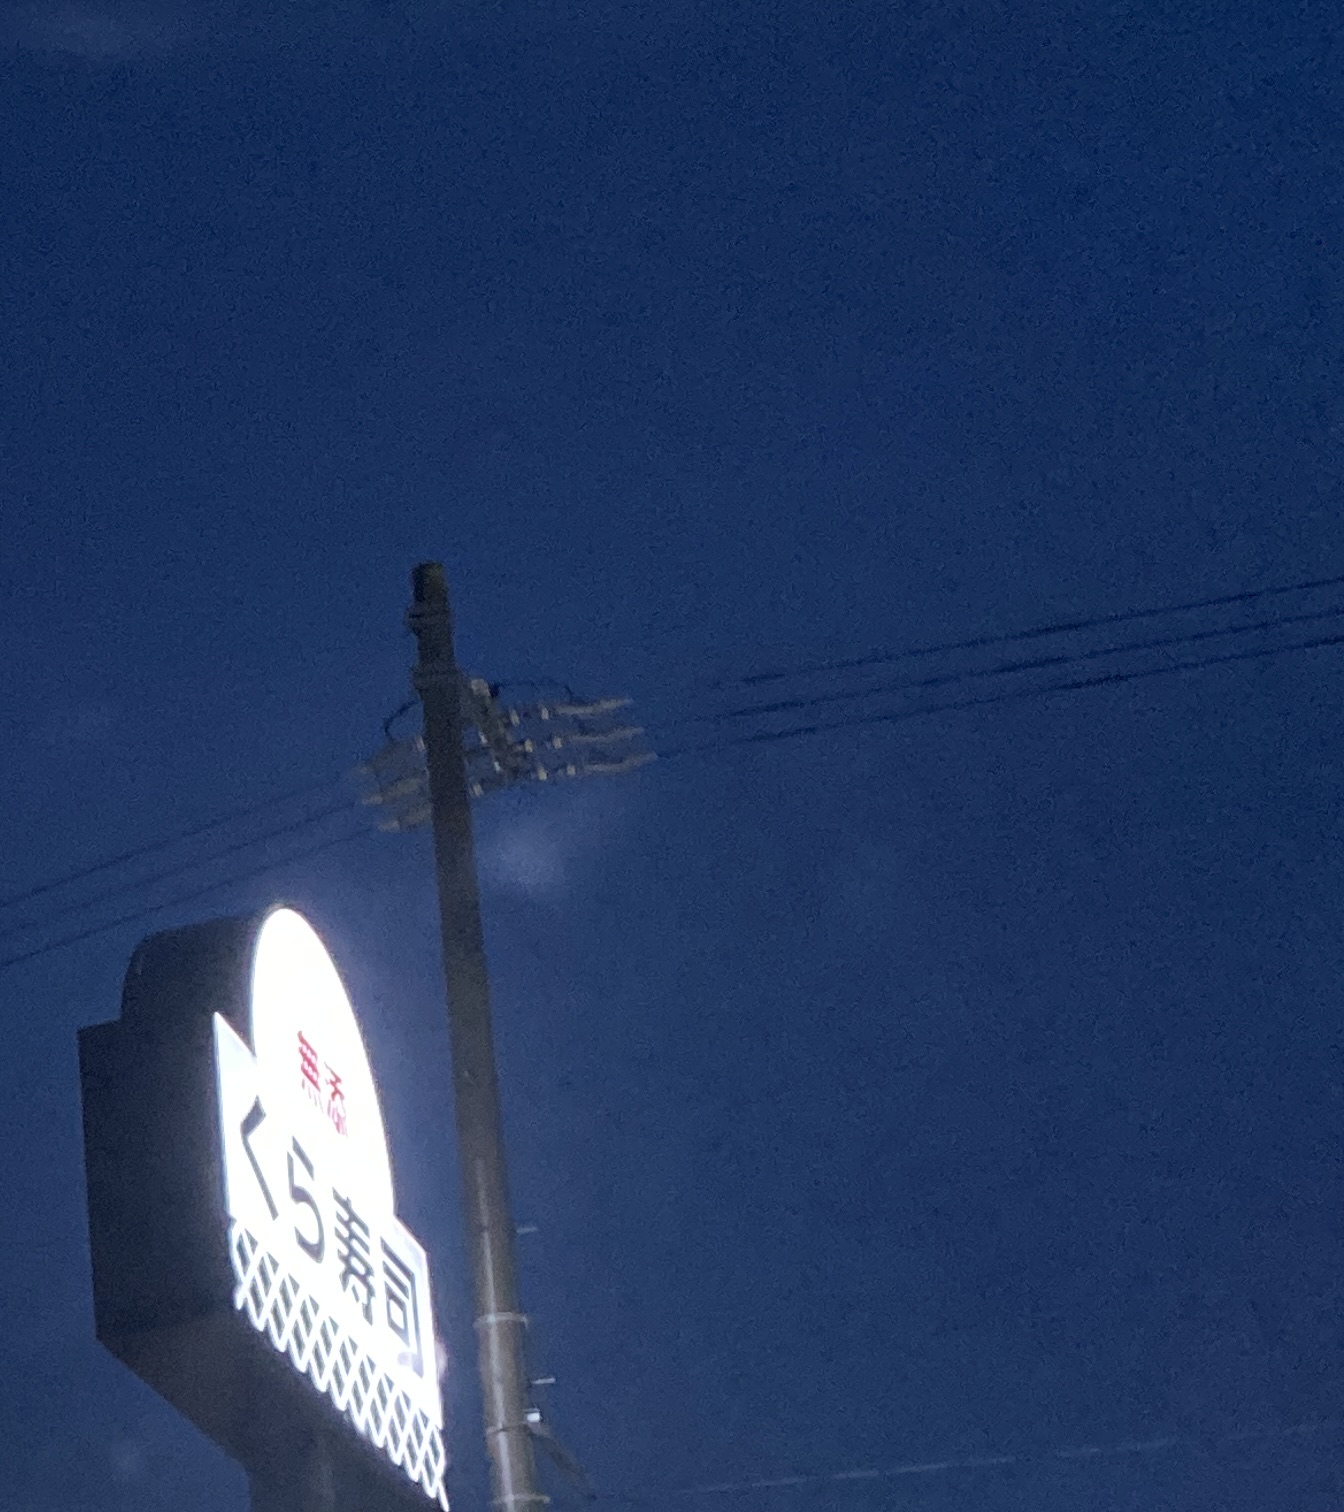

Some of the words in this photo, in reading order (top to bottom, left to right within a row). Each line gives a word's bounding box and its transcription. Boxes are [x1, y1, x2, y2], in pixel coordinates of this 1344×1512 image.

[296, 1029, 349, 1138] 無添
[239, 1094, 425, 1380] くら寿司
